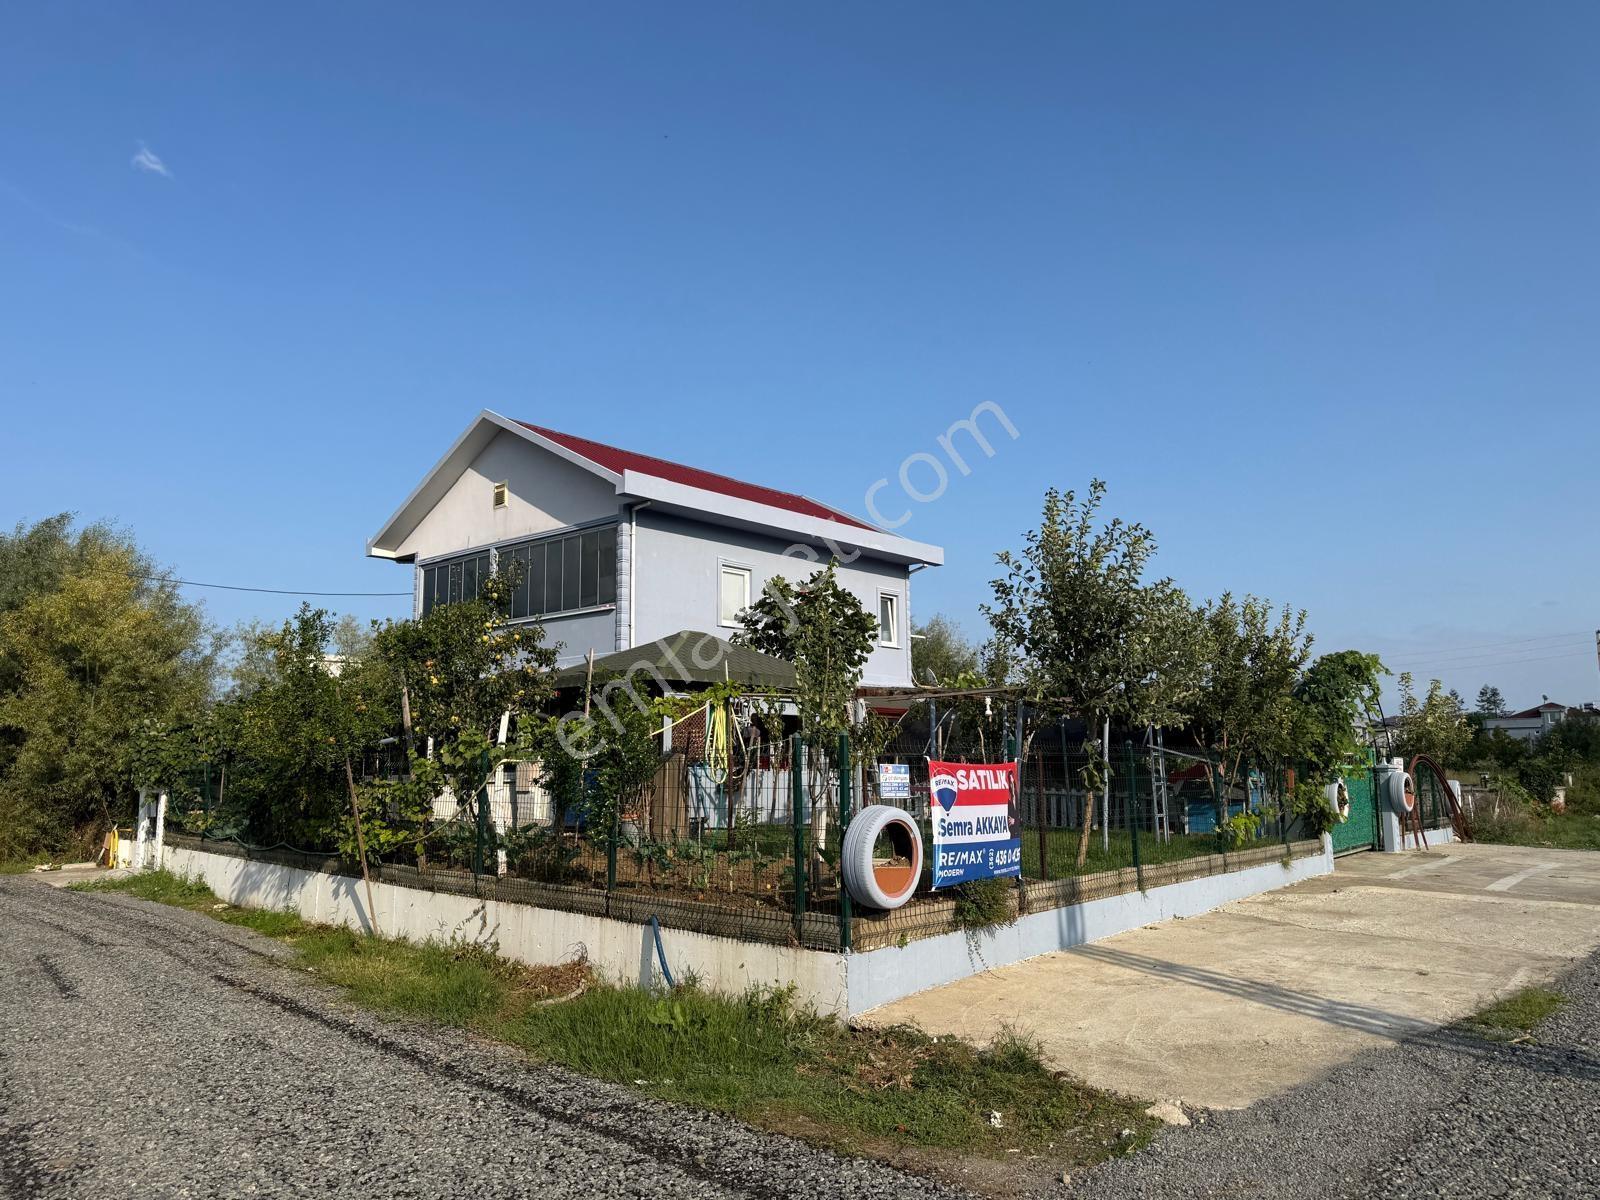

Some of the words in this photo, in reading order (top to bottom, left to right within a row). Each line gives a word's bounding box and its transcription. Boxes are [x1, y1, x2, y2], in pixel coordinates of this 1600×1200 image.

[934, 778, 955, 787] RE/MAX
[956, 769, 1010, 790] SATILIK
[938, 817, 973, 837] Semra
[975, 815, 1008, 835] AKKAYA
[939, 849, 983, 867] RE/MAX
[938, 868, 965, 878] MODERN
